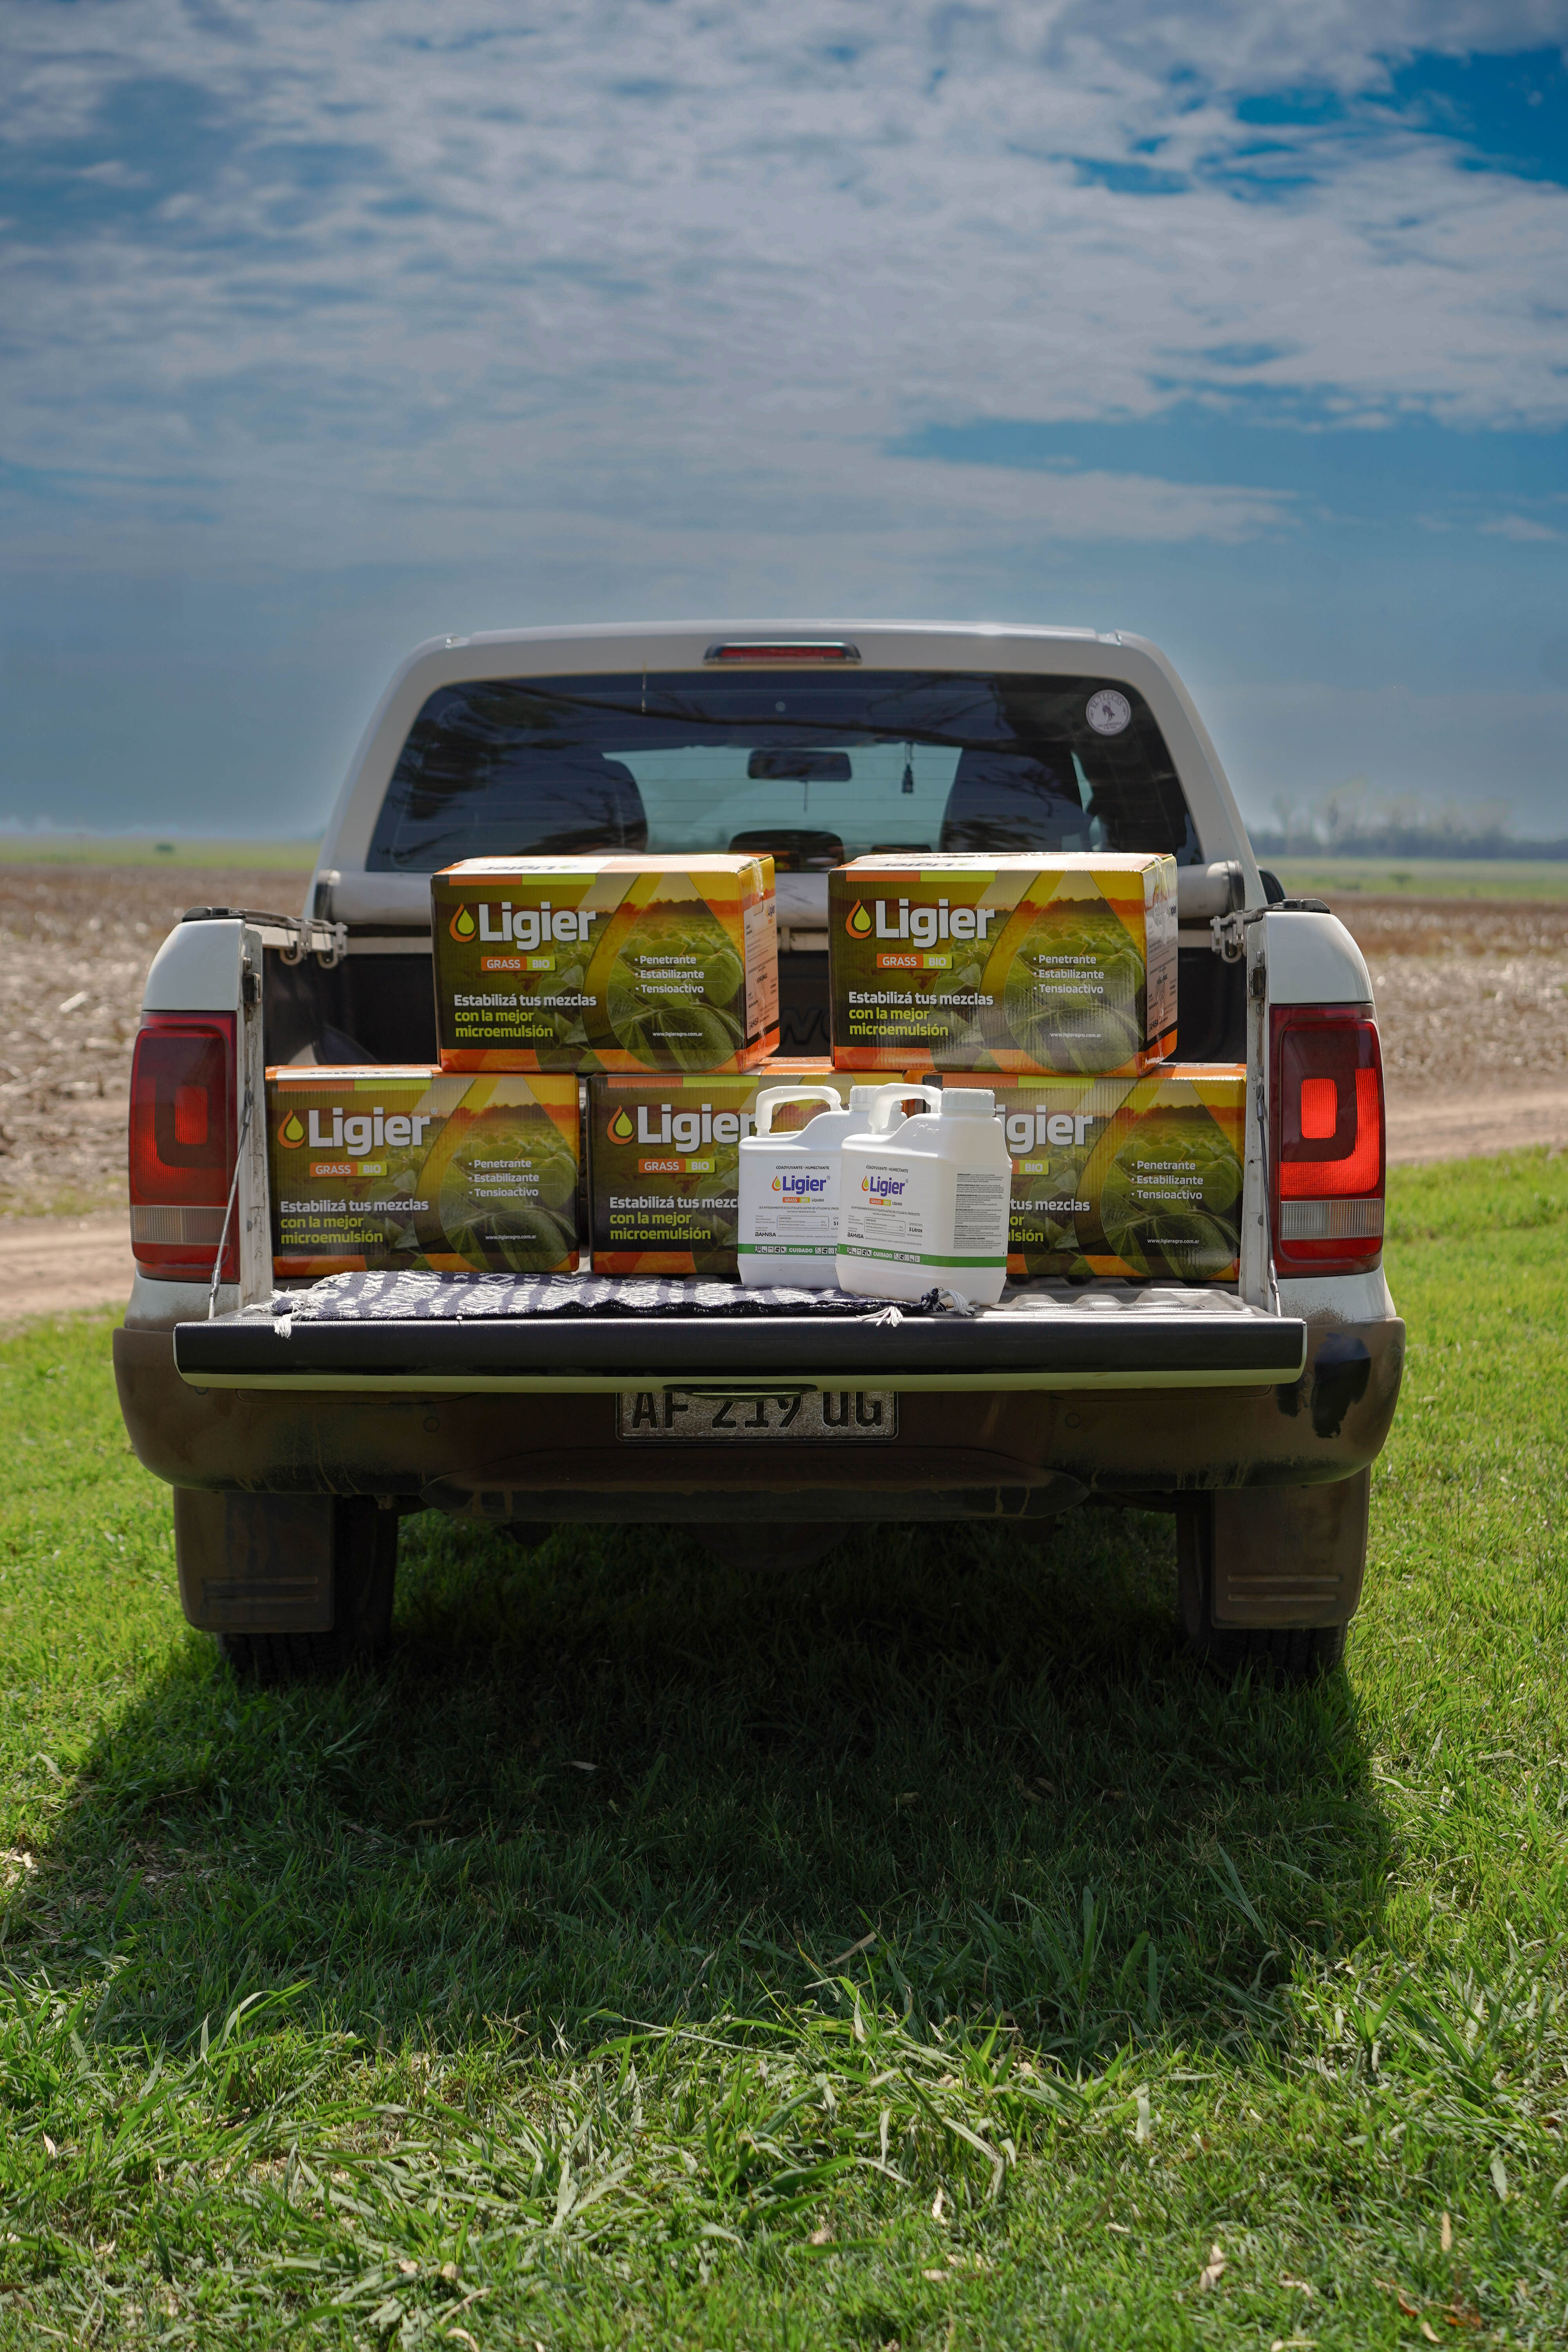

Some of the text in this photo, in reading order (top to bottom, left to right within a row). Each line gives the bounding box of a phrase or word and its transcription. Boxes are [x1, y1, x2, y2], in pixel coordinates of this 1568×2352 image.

[479, 902, 596, 950] Ligier
[876, 899, 995, 947] Ligier
[487, 960, 550, 968] GRASS BIO
[640, 956, 696, 964] Penetrante
[883, 957, 946, 966] GRASS BIO
[1039, 955, 1096, 964] Penetrante
[640, 969, 704, 978] Estabilizante
[1039, 970, 1103, 979] Estabilizante
[641, 984, 704, 993] Tensioactivo
[1039, 984, 1103, 993] Tensioactivo
[454, 994, 596, 1006] Estabilizá tus mezclas
[849, 991, 993, 1005] Estabilizá tus mezclas
[455, 1009, 534, 1025] con la mejor
[849, 1007, 929, 1022] con la mejor
[456, 1025, 553, 1037] microemulsión
[850, 1023, 948, 1036] microemulsión
[309, 1107, 430, 1155] Ligier
[638, 1104, 755, 1152] Ligier
[996, 1104, 1093, 1153] igier
[316, 1165, 381, 1174] GRASS BIO
[474, 1160, 531, 1168] Penetrante
[645, 1161, 709, 1171] GRASS BIO
[1025, 1163, 1043, 1172] BIO
[1137, 1161, 1196, 1170] Penetrante
[474, 1173, 539, 1182] Estabilizante
[1137, 1175, 1203, 1185] Estabilizante
[783, 1175, 826, 1194] Ligier
[870, 1176, 905, 1196] Ligier
[474, 1188, 538, 1196] Tensioactivo
[1137, 1190, 1202, 1200] Tensioactivo
[281, 1199, 428, 1212] Estabilizá tus mezclas
[610, 1196, 738, 1208] Estabilizá tus mezc
[1035, 1199, 1090, 1211] mezclas
[281, 1216, 363, 1230] con la mejor
[610, 1212, 691, 1226] con la mejor
[281, 1230, 383, 1243] microemulsión
[610, 1227, 711, 1240] microemulsión
[632, 1392, 688, 1428] AF
[823, 1392, 882, 1427] UG
